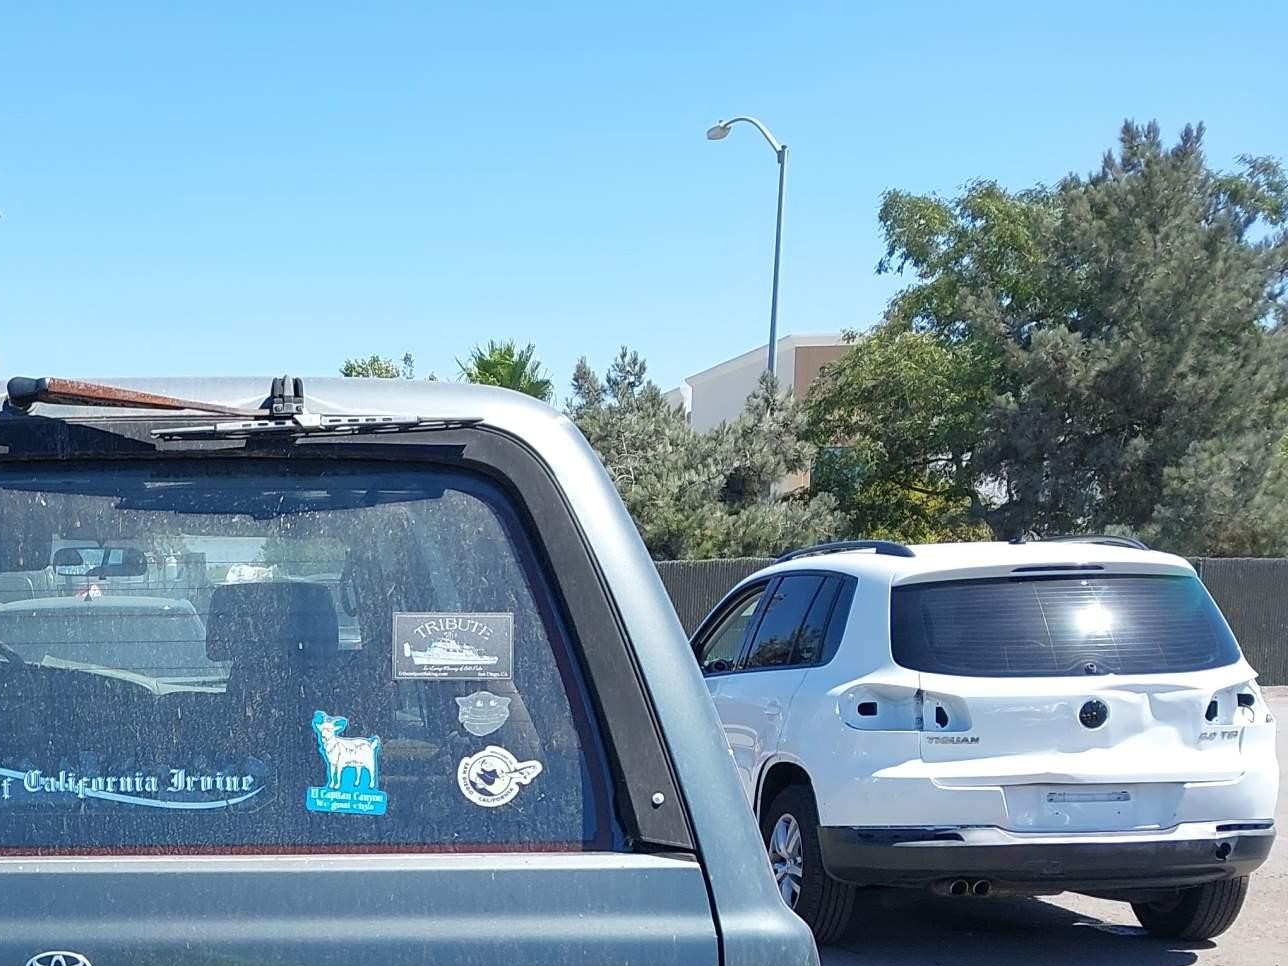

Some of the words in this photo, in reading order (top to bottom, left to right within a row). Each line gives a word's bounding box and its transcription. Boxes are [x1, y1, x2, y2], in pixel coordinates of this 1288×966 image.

[414, 617, 494, 640] TRIBUTE
[23, 769, 159, 799] California
[166, 768, 255, 793] Irvine
[311, 788, 319, 799] El
